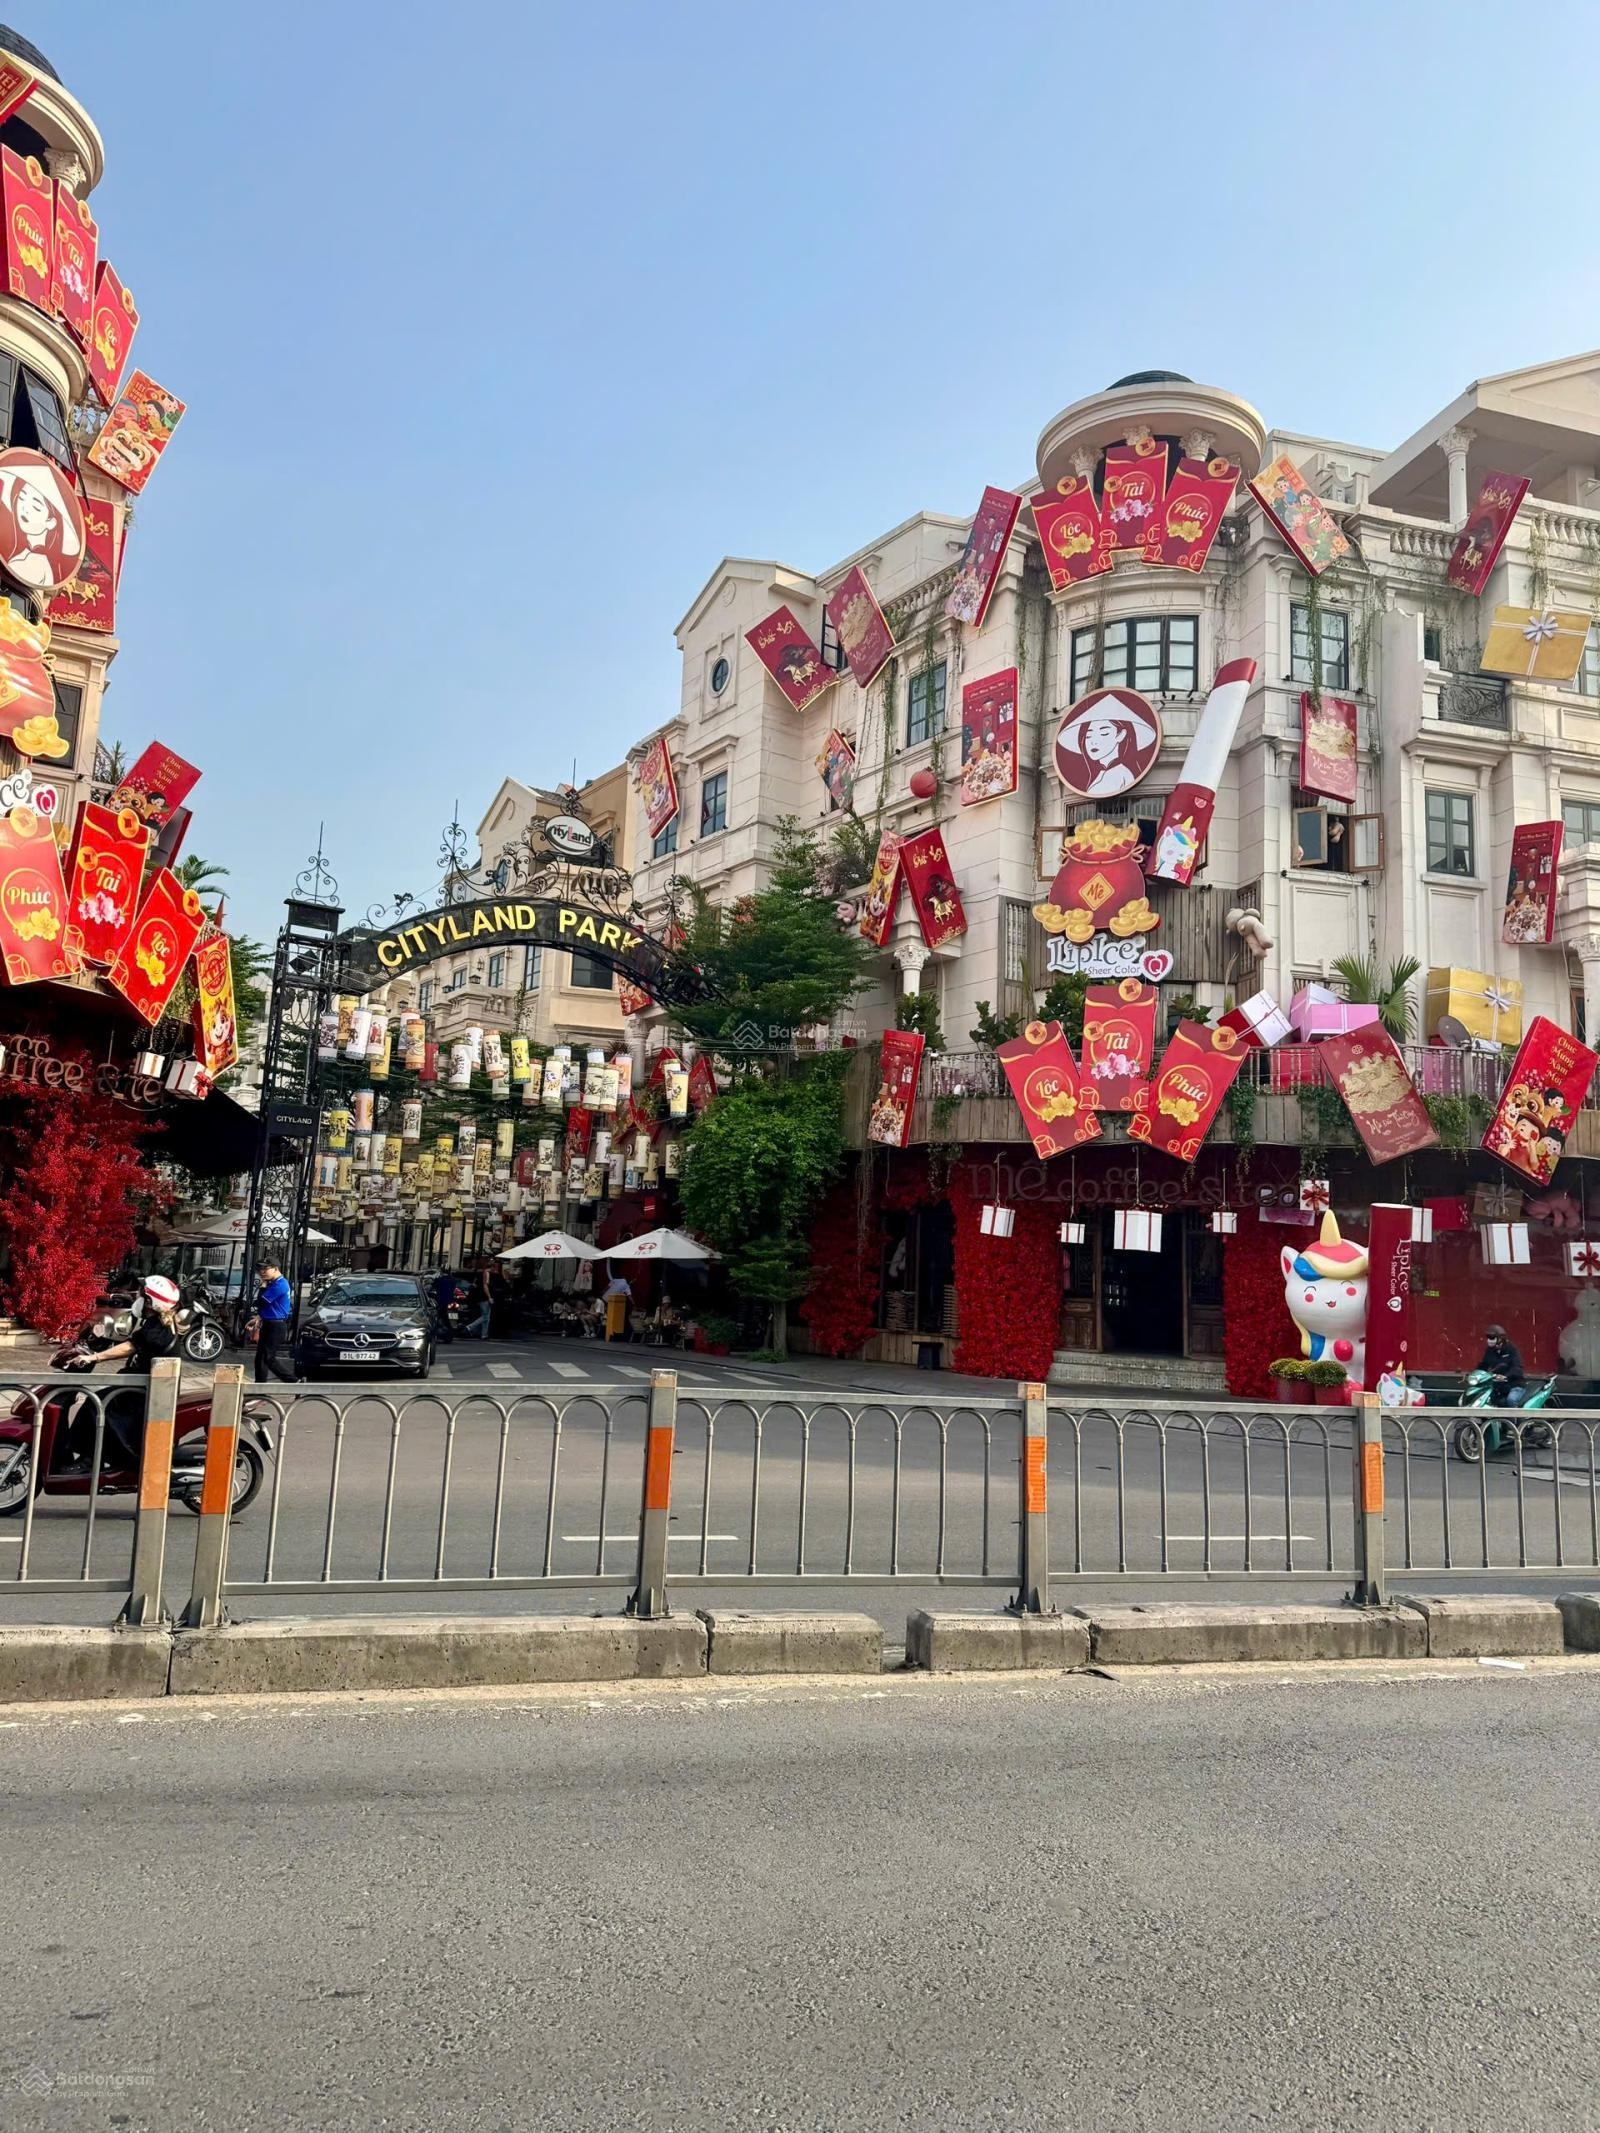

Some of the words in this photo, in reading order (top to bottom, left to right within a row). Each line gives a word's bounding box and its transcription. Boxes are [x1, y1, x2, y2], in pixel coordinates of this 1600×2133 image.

[16, 214, 45, 248] Phúc
[1122, 482, 1145, 498] Tài
[1175, 501, 1209, 521] Phúc
[1060, 522, 1081, 540] Lộc
[96, 867, 121, 893] Tài
[7, 886, 51, 905] Phúc
[377, 905, 536, 967] CITYLAND
[559, 908, 643, 954] PARK
[1088, 966, 1111, 975] Sheer
[1115, 966, 1140, 974] Color
[1104, 1032, 1129, 1050] Tài
[1036, 1079, 1060, 1099] Lộc
[1170, 1072, 1207, 1101] Phúc
[276, 1115, 312, 1125] CITYLAND
[1056, 1167, 1181, 1204] coffee
